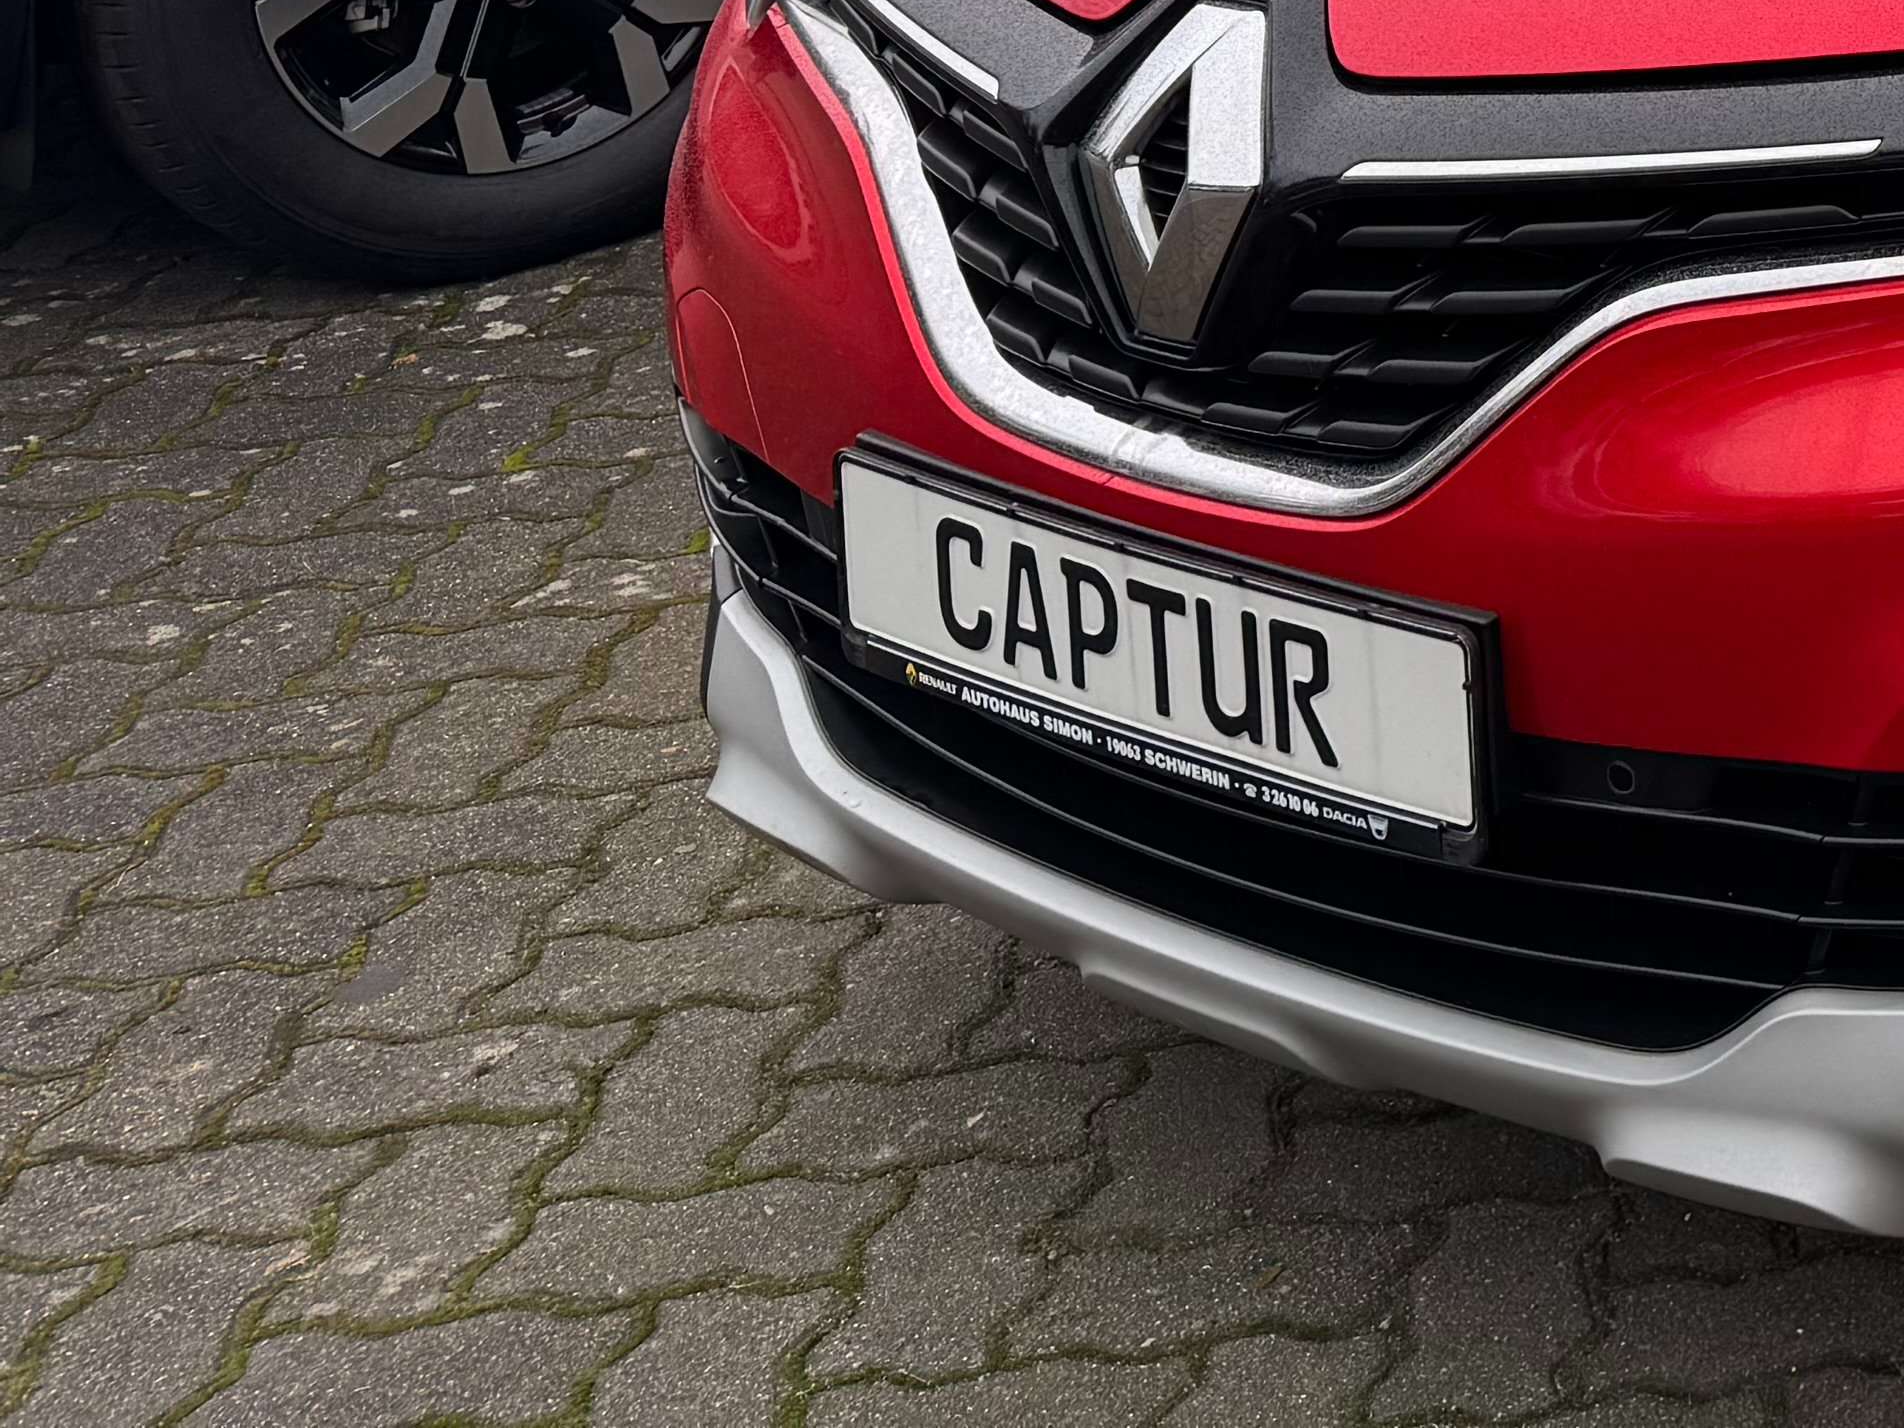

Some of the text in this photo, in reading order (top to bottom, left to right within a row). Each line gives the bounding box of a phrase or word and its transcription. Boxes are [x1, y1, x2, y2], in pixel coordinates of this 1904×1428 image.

[935, 516, 1340, 768] CAPTUR
[919, 672, 957, 695] RENAULT
[961, 686, 1040, 727] AUTOHAUS
[1043, 715, 1093, 745] SIMON
[1106, 736, 1141, 761] 19063
[1144, 749, 1230, 790] SCHWERIN
[1322, 806, 1368, 830] DACIA
